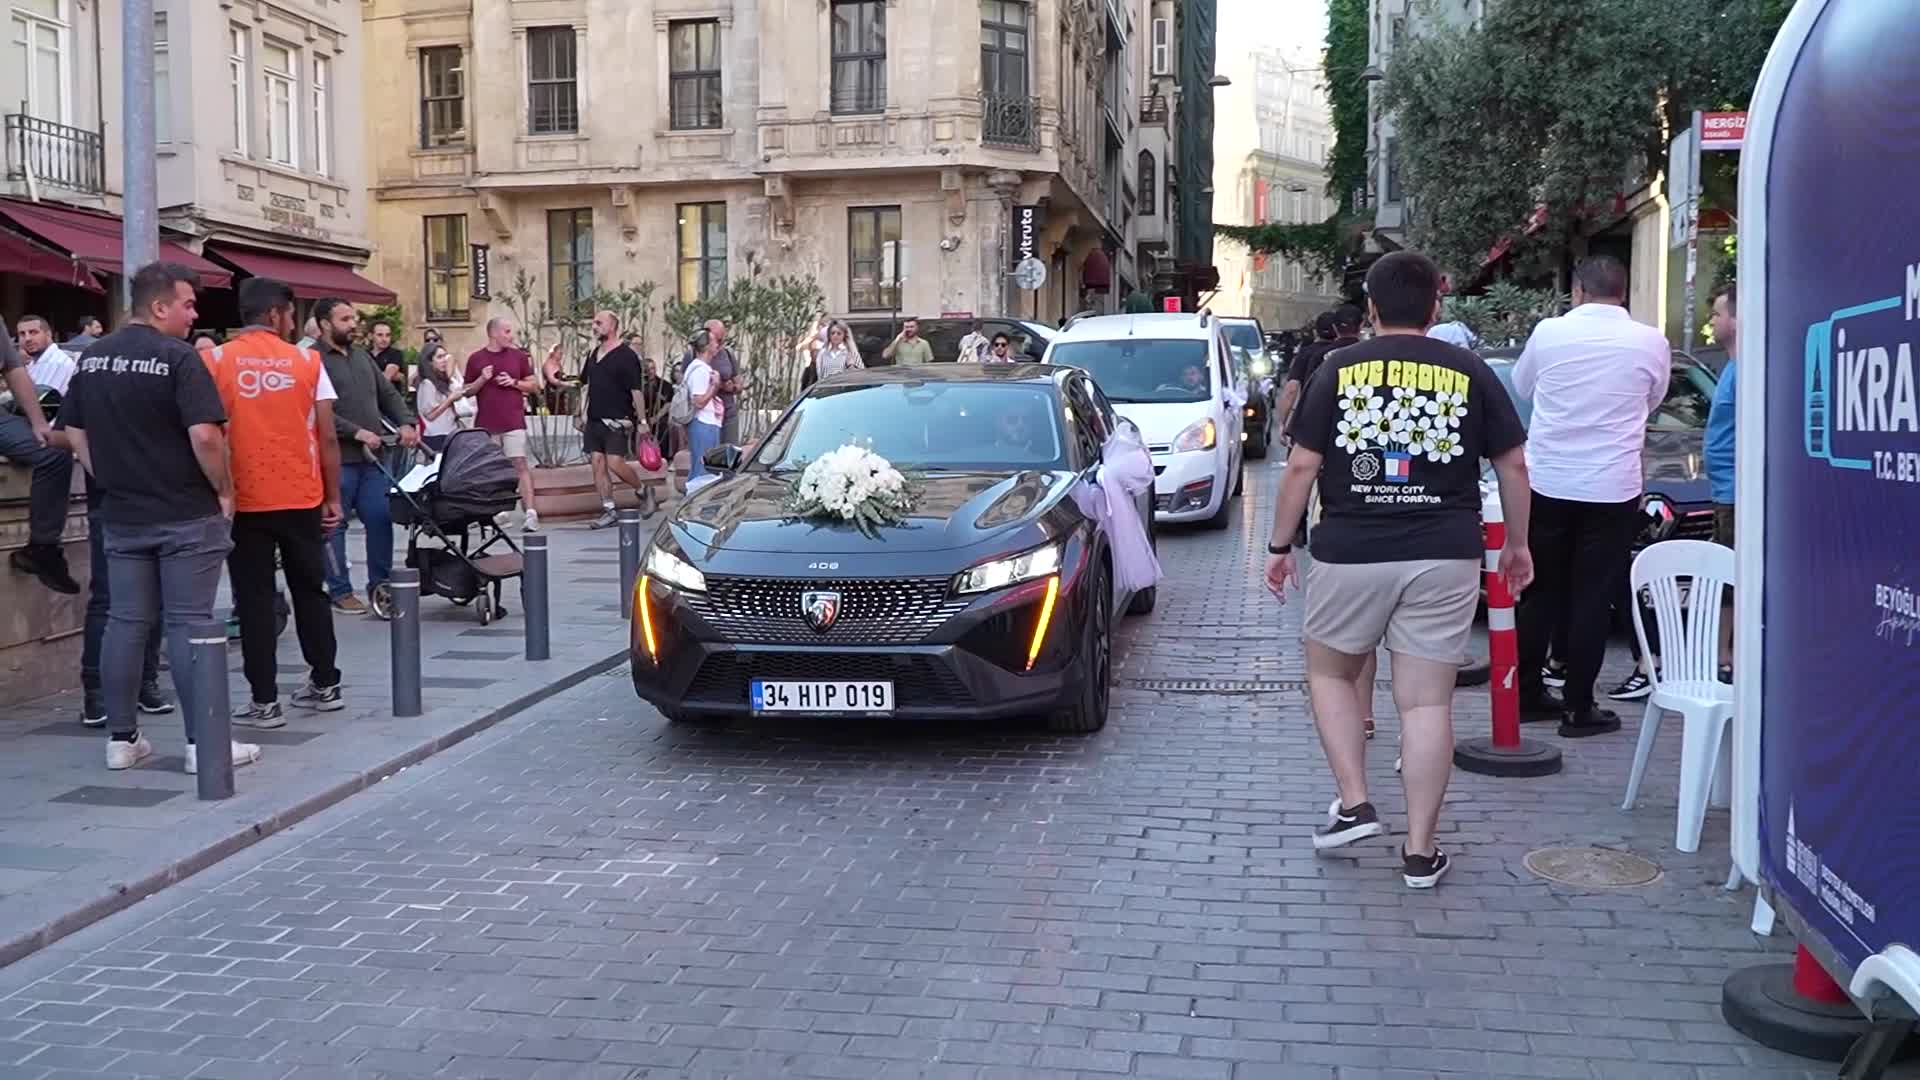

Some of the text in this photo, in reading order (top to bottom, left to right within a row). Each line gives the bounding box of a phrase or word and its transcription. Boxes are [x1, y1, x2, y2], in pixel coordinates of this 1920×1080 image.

[1704, 116, 1745, 128] NERGİZ
[1020, 208, 1032, 259] vitruta
[477, 249, 486, 295] vitruta
[131, 357, 169, 376] rules
[238, 369, 297, 399] go
[1386, 360, 1471, 403] GROWN
[1351, 484, 1425, 494] NEW YORK CITY
[1365, 495, 1394, 503] SINCE
[808, 562, 839, 570] 408
[764, 684, 789, 707] 34
[798, 684, 837, 707] HIP
[846, 684, 885, 707] 019
